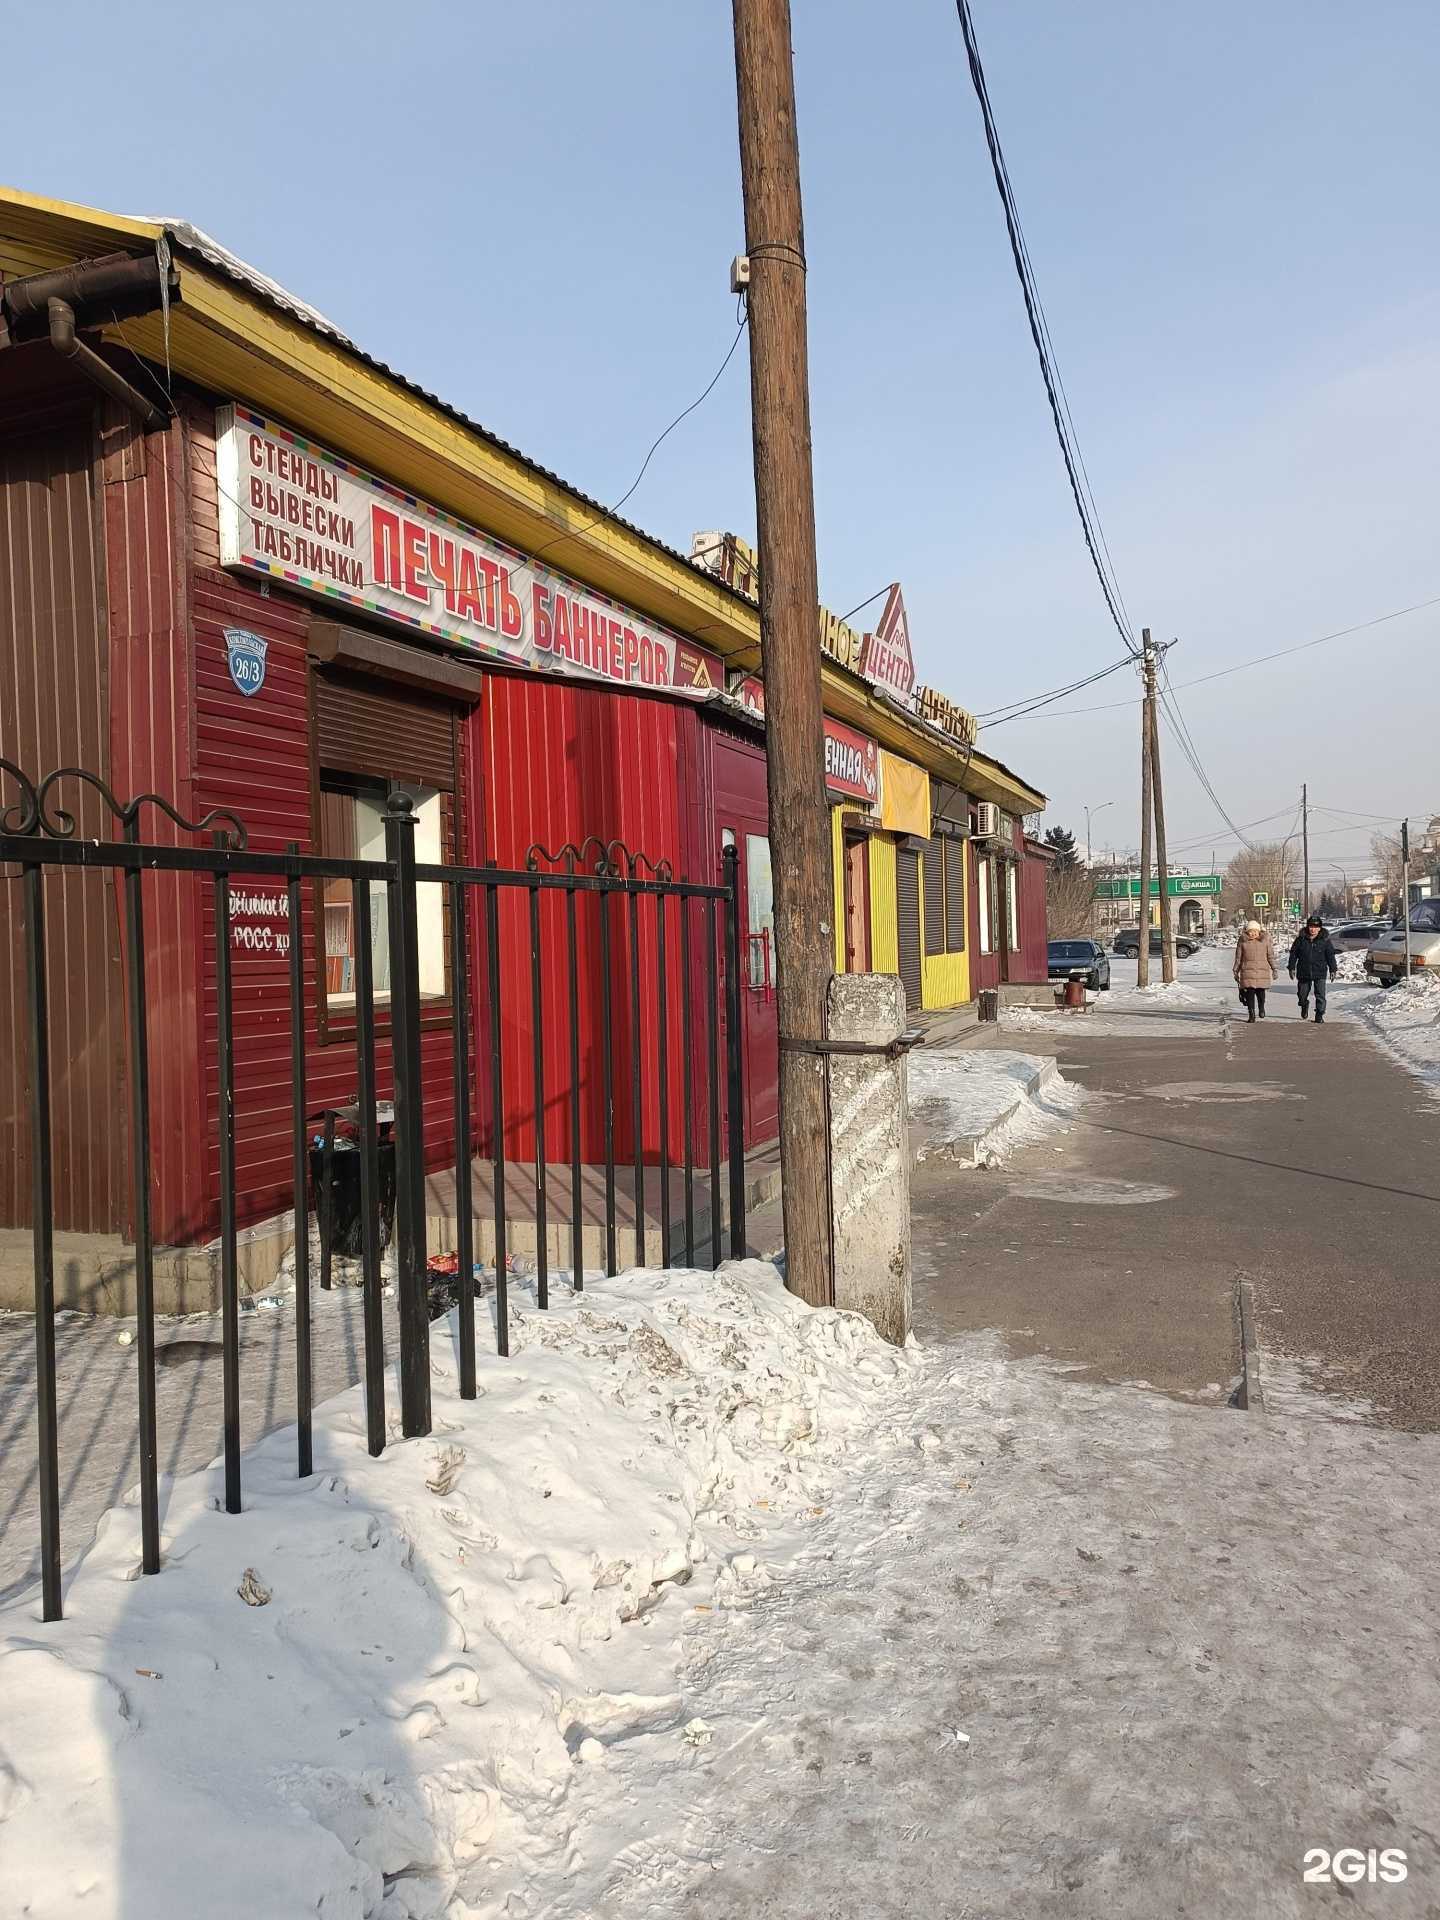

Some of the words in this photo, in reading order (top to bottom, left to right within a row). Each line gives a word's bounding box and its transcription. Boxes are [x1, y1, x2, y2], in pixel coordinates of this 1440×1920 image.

[249, 434, 339, 503] СТЕНДЫ
[250, 475, 354, 549] ВЫВЕСКИ
[250, 518, 364, 590] ТАБЛИЧКИ
[371, 503, 523, 636] ПЕЧАТЬ
[532, 581, 671, 686] БАННЕРОВ
[235, 657, 260, 682] 26/3
[868, 640, 911, 694] ЦЕНТР
